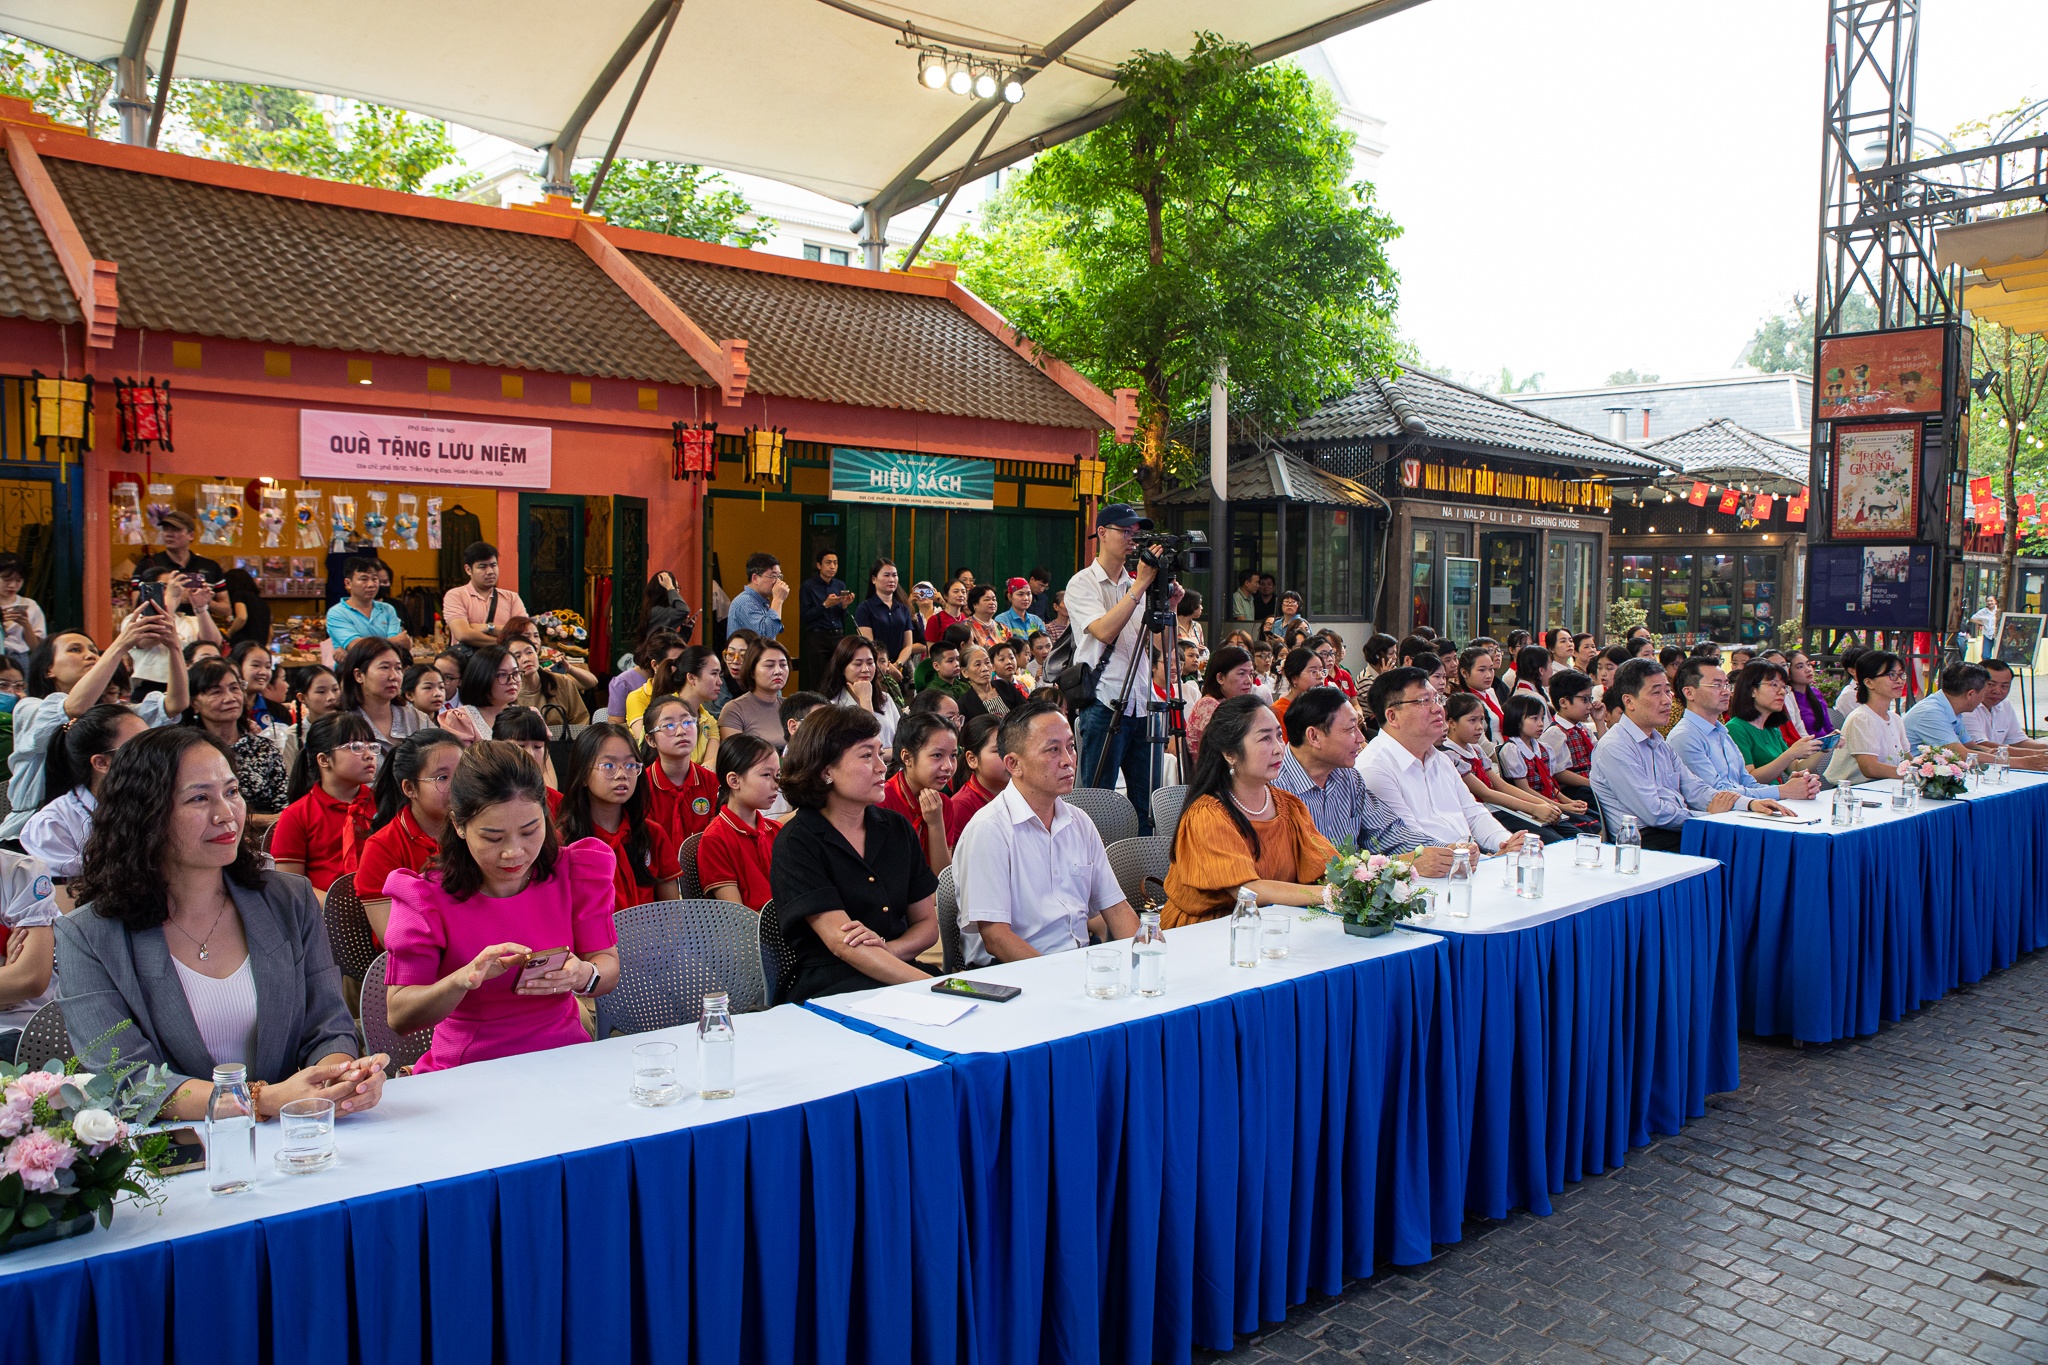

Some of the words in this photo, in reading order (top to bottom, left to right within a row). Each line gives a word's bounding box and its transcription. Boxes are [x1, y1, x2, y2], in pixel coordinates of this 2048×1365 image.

[330, 430, 370, 454] QUÀ
[378, 435, 430, 460] TẶNG
[438, 442, 474, 461] LƯU
[481, 443, 527, 466] NIỆM
[1856, 450, 1895, 463] TRONG
[870, 467, 912, 493] HIỆU
[917, 470, 962, 492] SÁCH
[1404, 459, 1420, 487] ST
[1425, 458, 1446, 491] NHÀ
[1449, 459, 1472, 494] XUẤT
[1475, 464, 1494, 496] BẢN
[1496, 467, 1523, 499] CHÍNH
[1526, 476, 1539, 506] TRỊ
[1541, 471, 1564, 504] QUỐC
[1565, 480, 1578, 505] GIA
[1558, 518, 1580, 528] HOUSE
